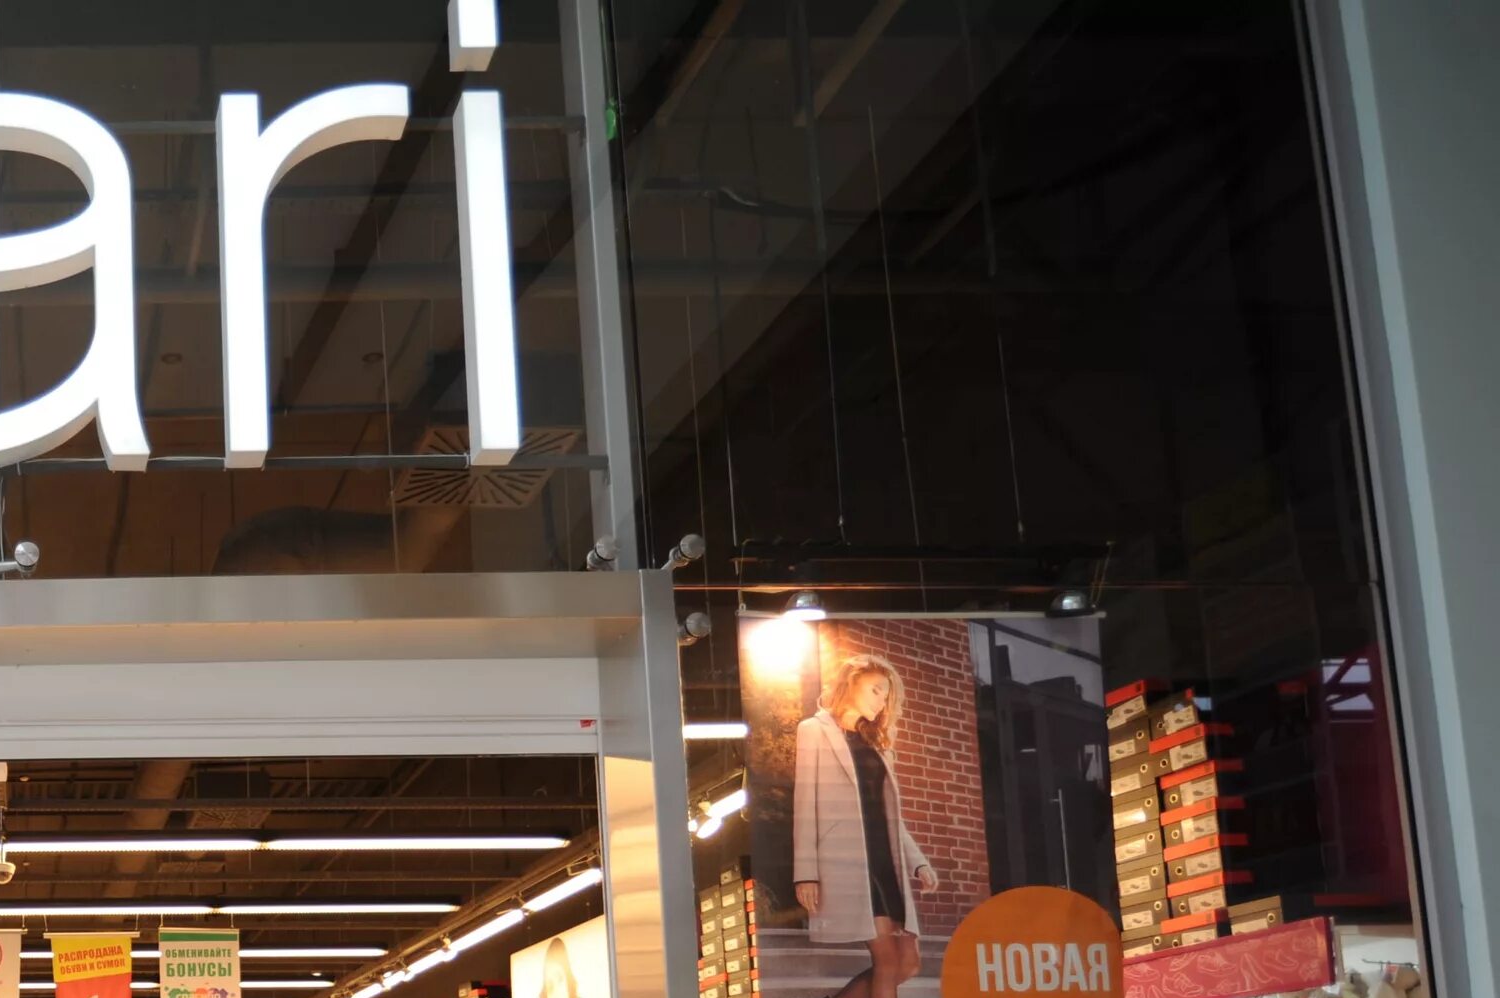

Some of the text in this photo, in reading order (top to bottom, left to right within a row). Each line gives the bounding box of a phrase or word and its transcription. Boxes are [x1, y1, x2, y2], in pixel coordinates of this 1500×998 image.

[58, 944, 123, 963] РАСПРОДАЖА
[165, 947, 232, 958] ОБМЕНИВАЙТЕ
[166, 962, 232, 978] БОНУСЫ
[976, 943, 1112, 992] НОВАЯ
